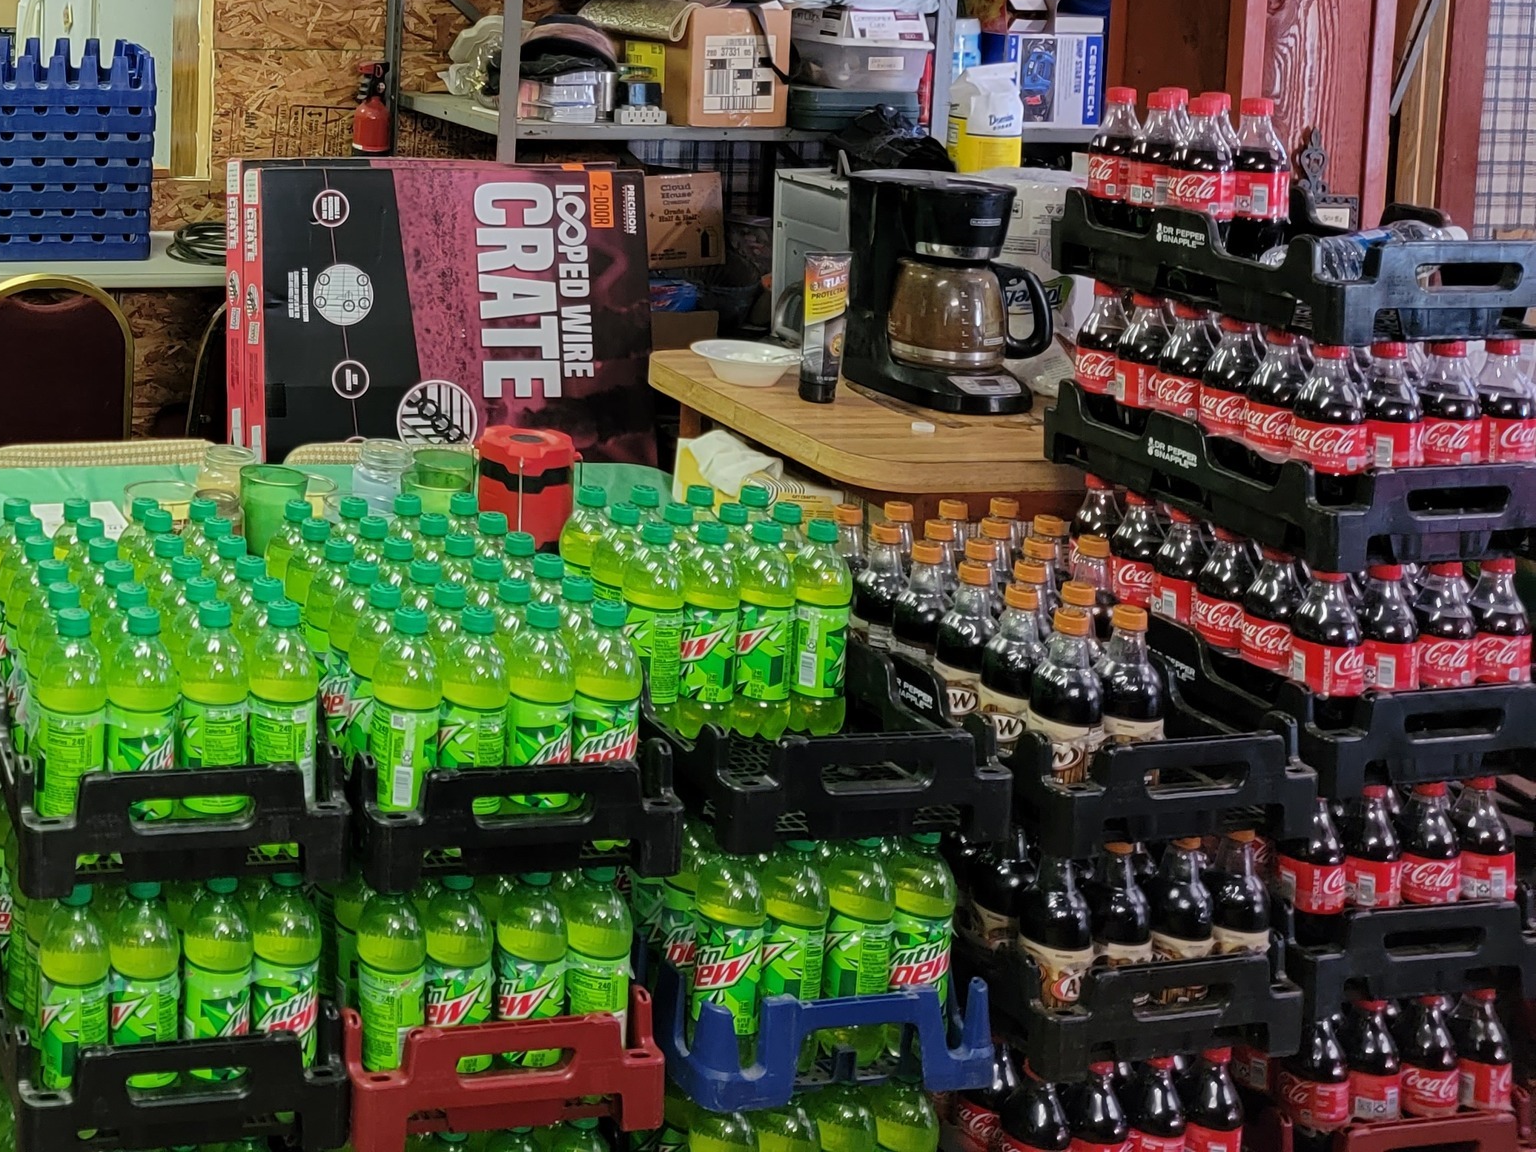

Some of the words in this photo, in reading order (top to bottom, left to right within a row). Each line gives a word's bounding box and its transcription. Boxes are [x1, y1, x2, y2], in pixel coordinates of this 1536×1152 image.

[721, 48, 740, 56] 37331
[592, 184, 610, 224] 2-DOOR
[627, 184, 636, 235] PRECISION
[227, 196, 237, 250] CRATE
[1164, 225, 1174, 235] DR
[1176, 228, 1206, 241] PEPPER
[244, 208, 256, 262] CRATE
[1162, 235, 1197, 249] SNAPPLE
[474, 182, 562, 398] CRATE
[811, 288, 846, 300] PROTECTAN
[560, 304, 594, 378] WIRE
[1154, 450, 1189, 469] SNAPPLE
[1155, 440, 1165, 449] DR
[1167, 444, 1197, 462] PEPPER
[903, 680, 933, 706] PEPPER
[279, 725, 292, 733] 240
[72, 738, 85, 746] 240
[598, 981, 611, 990] 240
